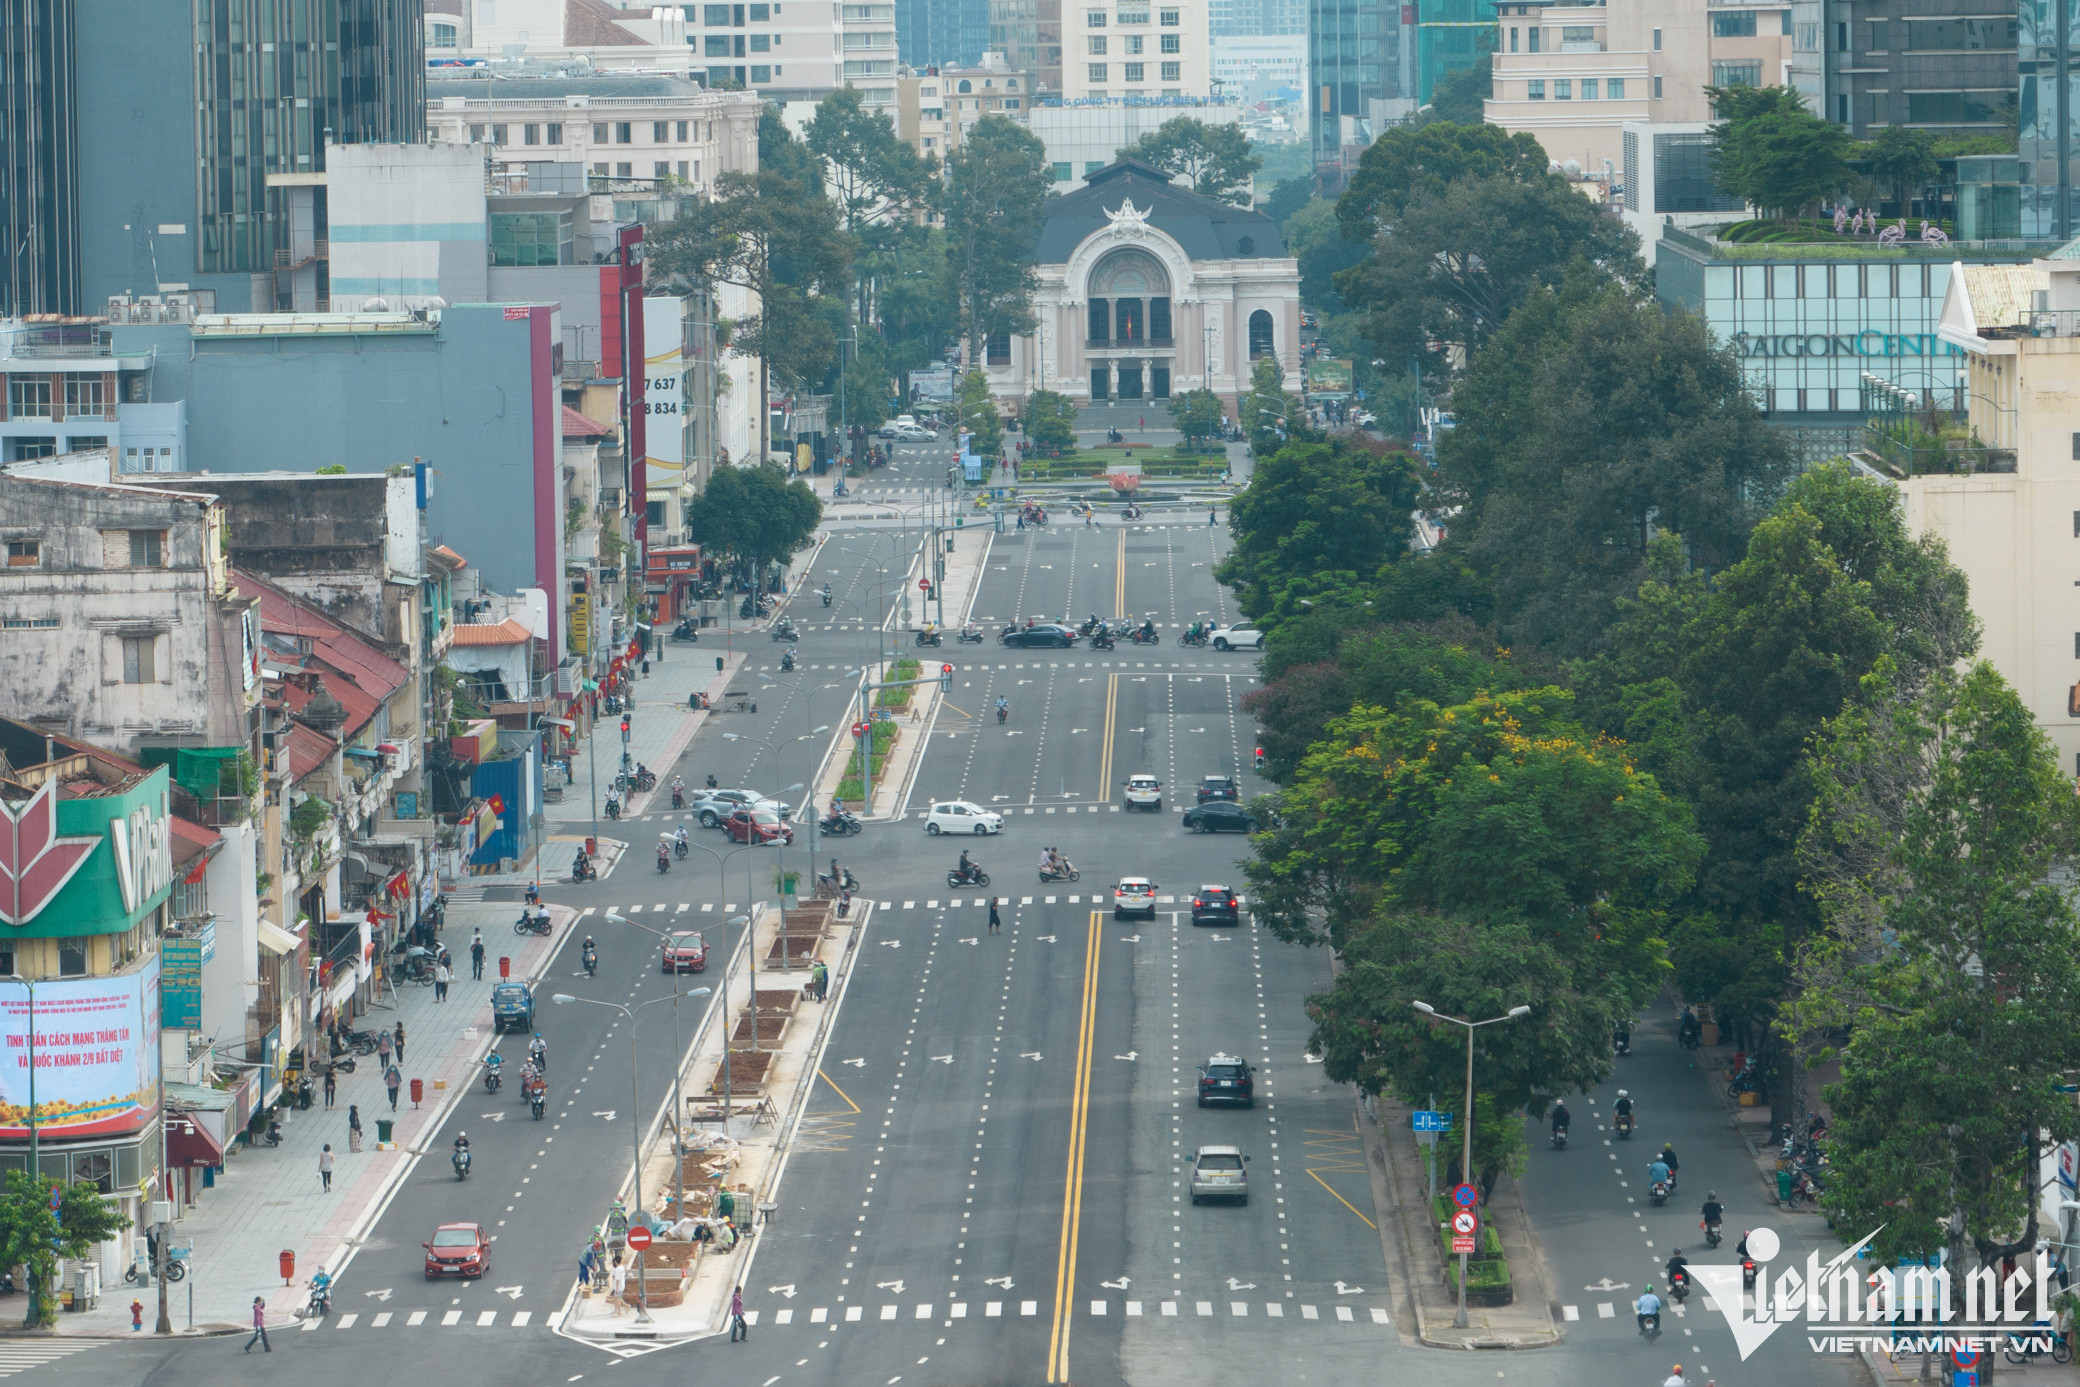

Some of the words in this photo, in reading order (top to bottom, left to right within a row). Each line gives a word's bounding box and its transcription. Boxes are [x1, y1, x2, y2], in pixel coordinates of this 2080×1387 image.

[654, 378, 676, 390] 637
[654, 402, 677, 415] 834
[110, 790, 173, 914] VPBank
[6, 1035, 24, 1048] TINH
[49, 1032, 71, 1046] CÁCH
[73, 1032, 95, 1048] MẠNG
[96, 1028, 118, 1043] THÁNG
[119, 1026, 130, 1041] TÁM
[18, 1053, 29, 1068] VÀ
[54, 1051, 81, 1067] KHÁNH
[82, 1052, 94, 1065] 2/9
[96, 1048, 109, 1064] BẤT
[110, 1048, 123, 1065] DIỆT
